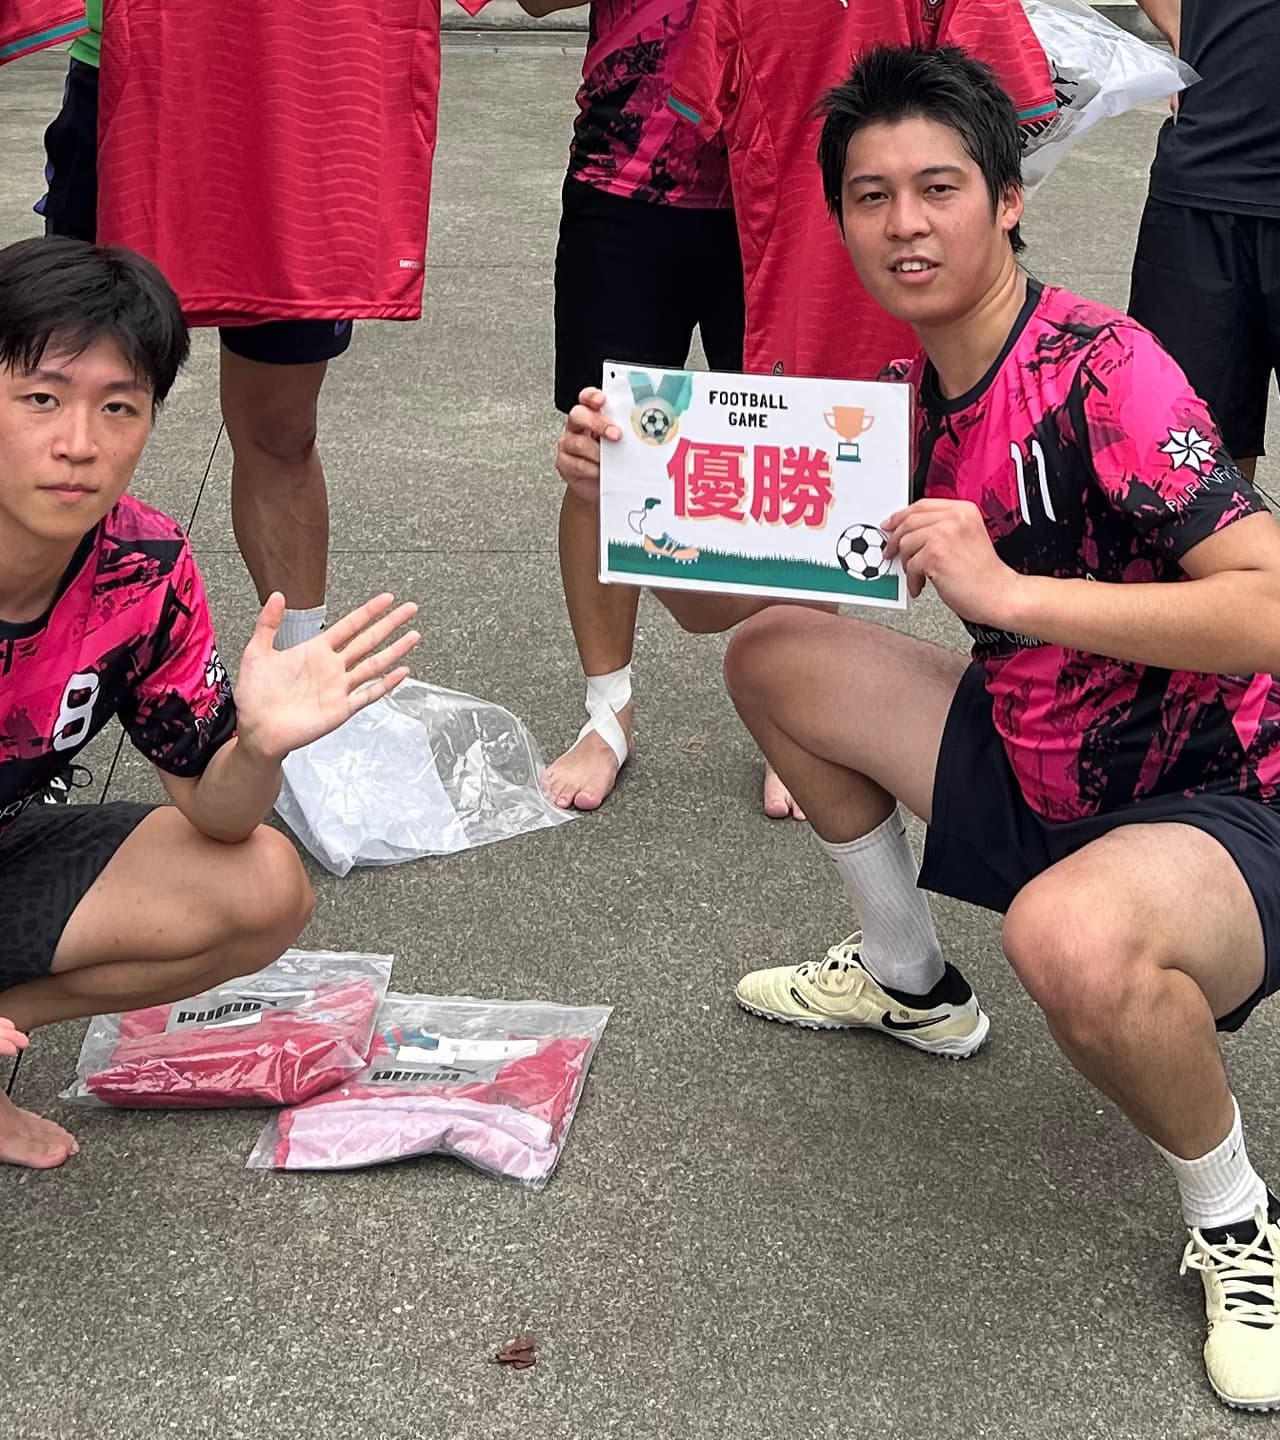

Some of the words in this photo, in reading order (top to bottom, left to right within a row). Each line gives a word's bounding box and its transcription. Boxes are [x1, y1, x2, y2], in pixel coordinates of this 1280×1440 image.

[709, 390, 789, 410] FOOTBALL
[728, 412, 768, 428] GAME
[666, 436, 834, 527] 優勝
[1010, 439, 1056, 526] 11
[53, 672, 100, 752] 8
[177, 1001, 262, 1023] PUMA
